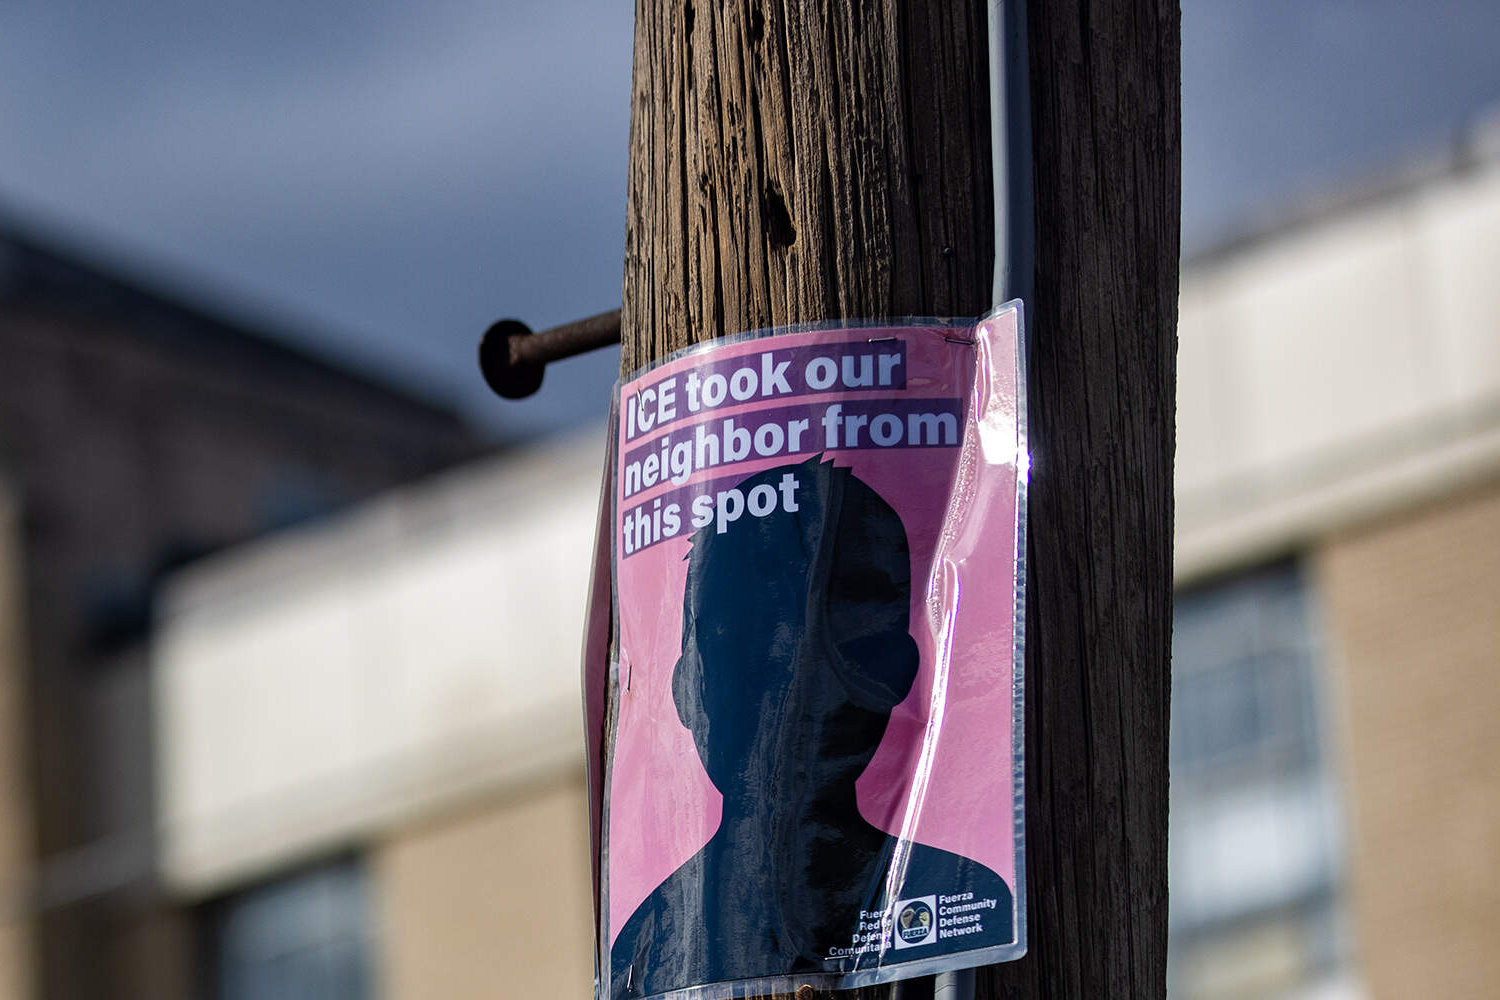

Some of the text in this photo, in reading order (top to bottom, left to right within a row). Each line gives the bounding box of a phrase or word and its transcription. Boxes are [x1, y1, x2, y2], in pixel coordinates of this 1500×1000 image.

[627, 352, 901, 439] ICE took our
[624, 403, 958, 497] neighbor from
[623, 472, 800, 556] this spot
[938, 892, 974, 905] Fuerza
[859, 908, 891, 920] Fuer
[938, 898, 998, 917] Community
[859, 919, 880, 931] Red
[939, 912, 981, 928] Defense
[939, 922, 983, 939] Network
